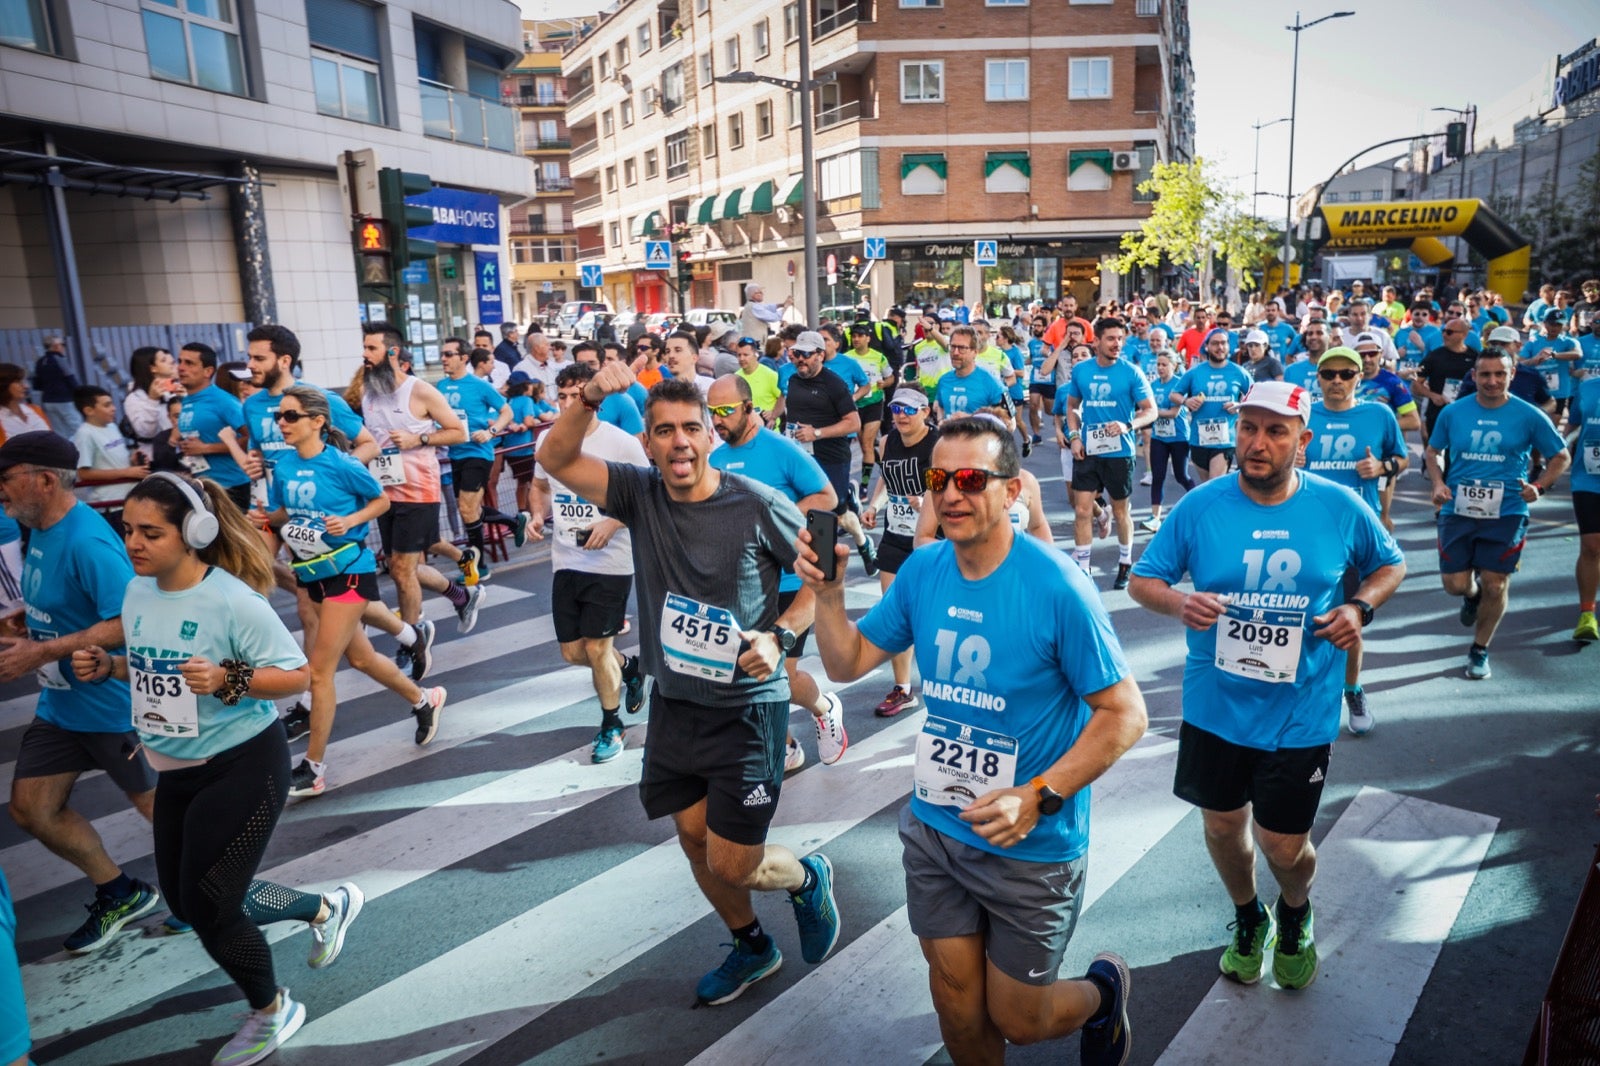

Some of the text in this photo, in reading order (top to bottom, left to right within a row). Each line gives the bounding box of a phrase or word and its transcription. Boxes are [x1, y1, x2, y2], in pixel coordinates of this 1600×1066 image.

[431, 206, 497, 229] ABAHOMES
[1339, 206, 1459, 228] MARCELINO
[924, 244, 964, 257] Puerta
[1088, 382, 1113, 401] 18
[1319, 433, 1357, 461] 18
[1470, 429, 1503, 454] 18
[1309, 460, 1358, 471] MARCELIN
[1461, 451, 1507, 463] MARCELINO
[286, 480, 317, 510] 18
[1462, 486, 1495, 501] 1651
[559, 503, 594, 518] 2002
[892, 503, 914, 517] 934
[287, 525, 316, 543] 2268
[1242, 547, 1303, 593] 18
[1227, 592, 1310, 610] MARCELINO
[671, 614, 730, 646] 4515
[1227, 619, 1289, 647] 2098
[685, 638, 708, 650] MIGUEL
[1248, 643, 1264, 652] LUIS
[934, 628, 991, 690] 18
[135, 671, 182, 698] 2163
[922, 679, 1006, 712] MARCELINO
[930, 738, 999, 778] 2218
[937, 765, 969, 779] ANTONIO
[743, 795, 772, 806] adidas
